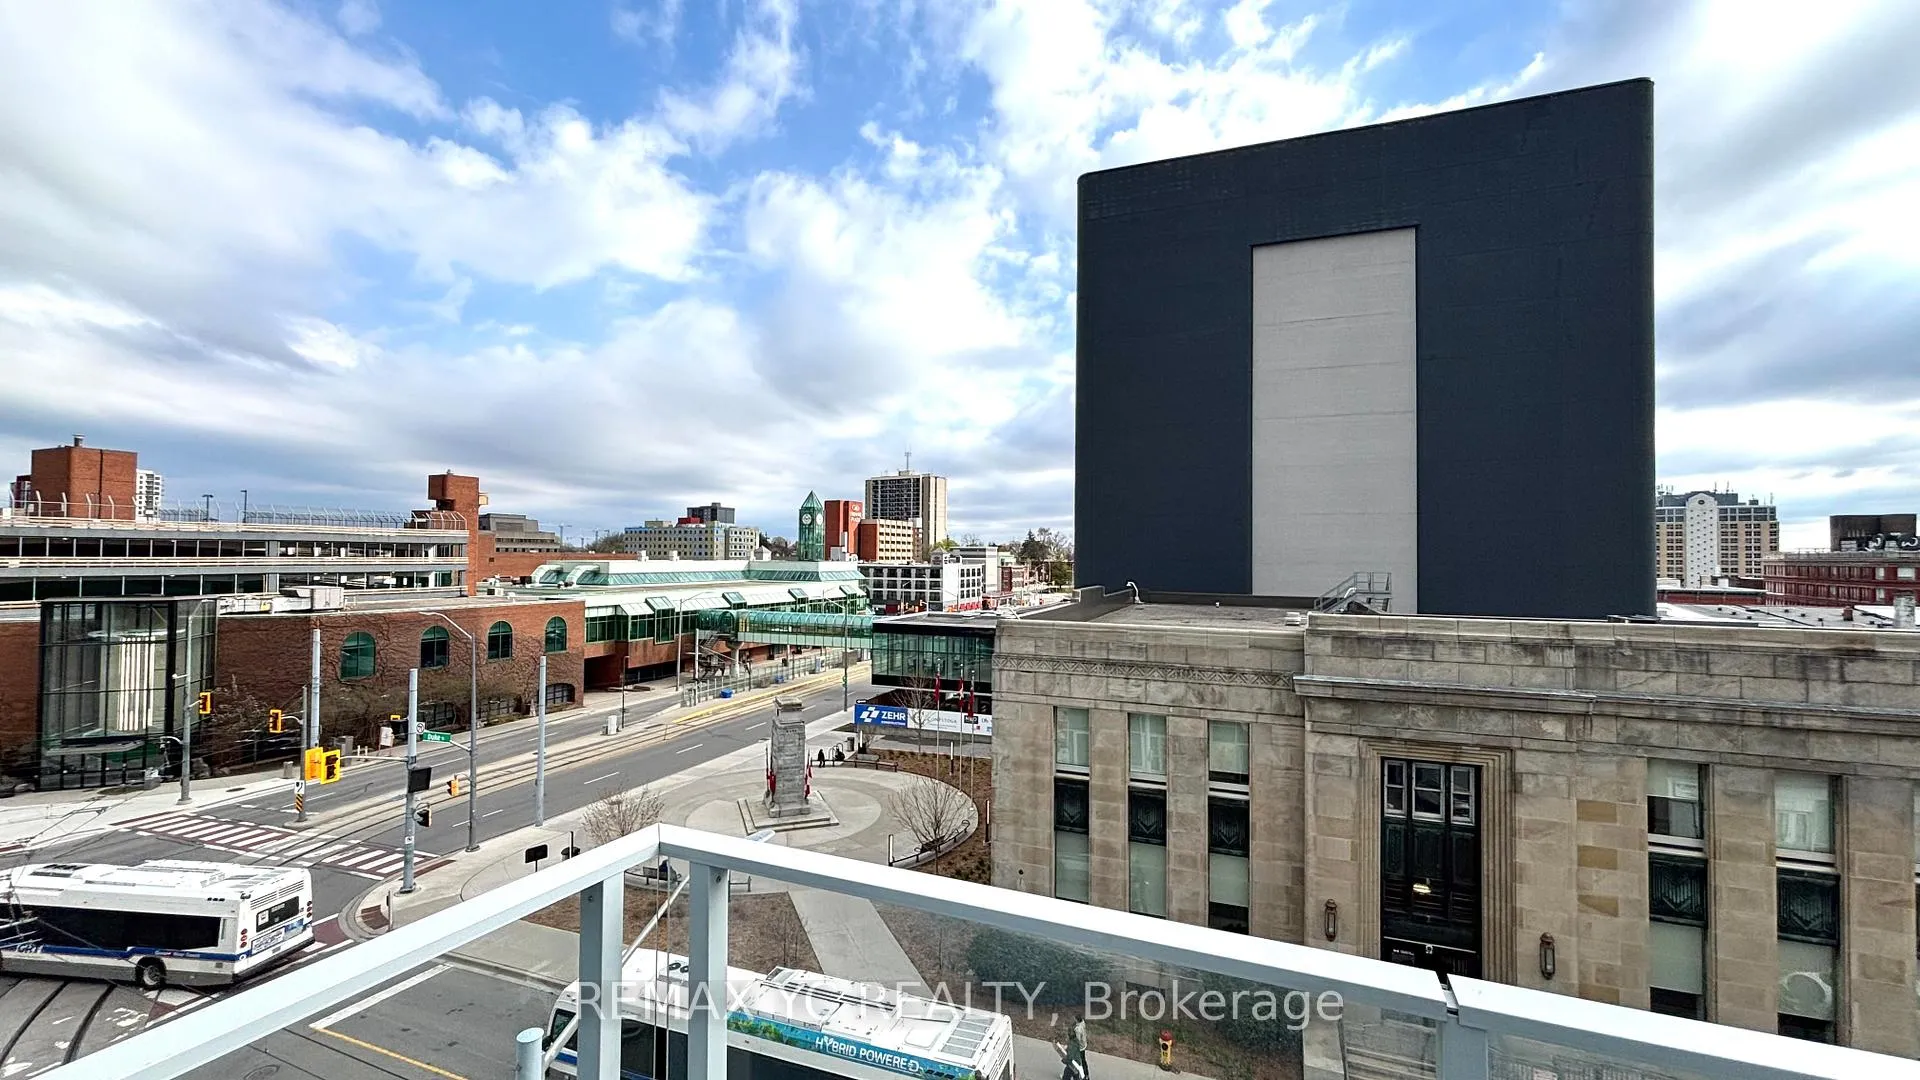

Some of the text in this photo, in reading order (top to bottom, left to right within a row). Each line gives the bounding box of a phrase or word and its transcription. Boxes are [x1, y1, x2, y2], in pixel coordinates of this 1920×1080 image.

[881, 710, 906, 721] ZEHR
[815, 1035, 921, 1073] HYBRID POWERED
